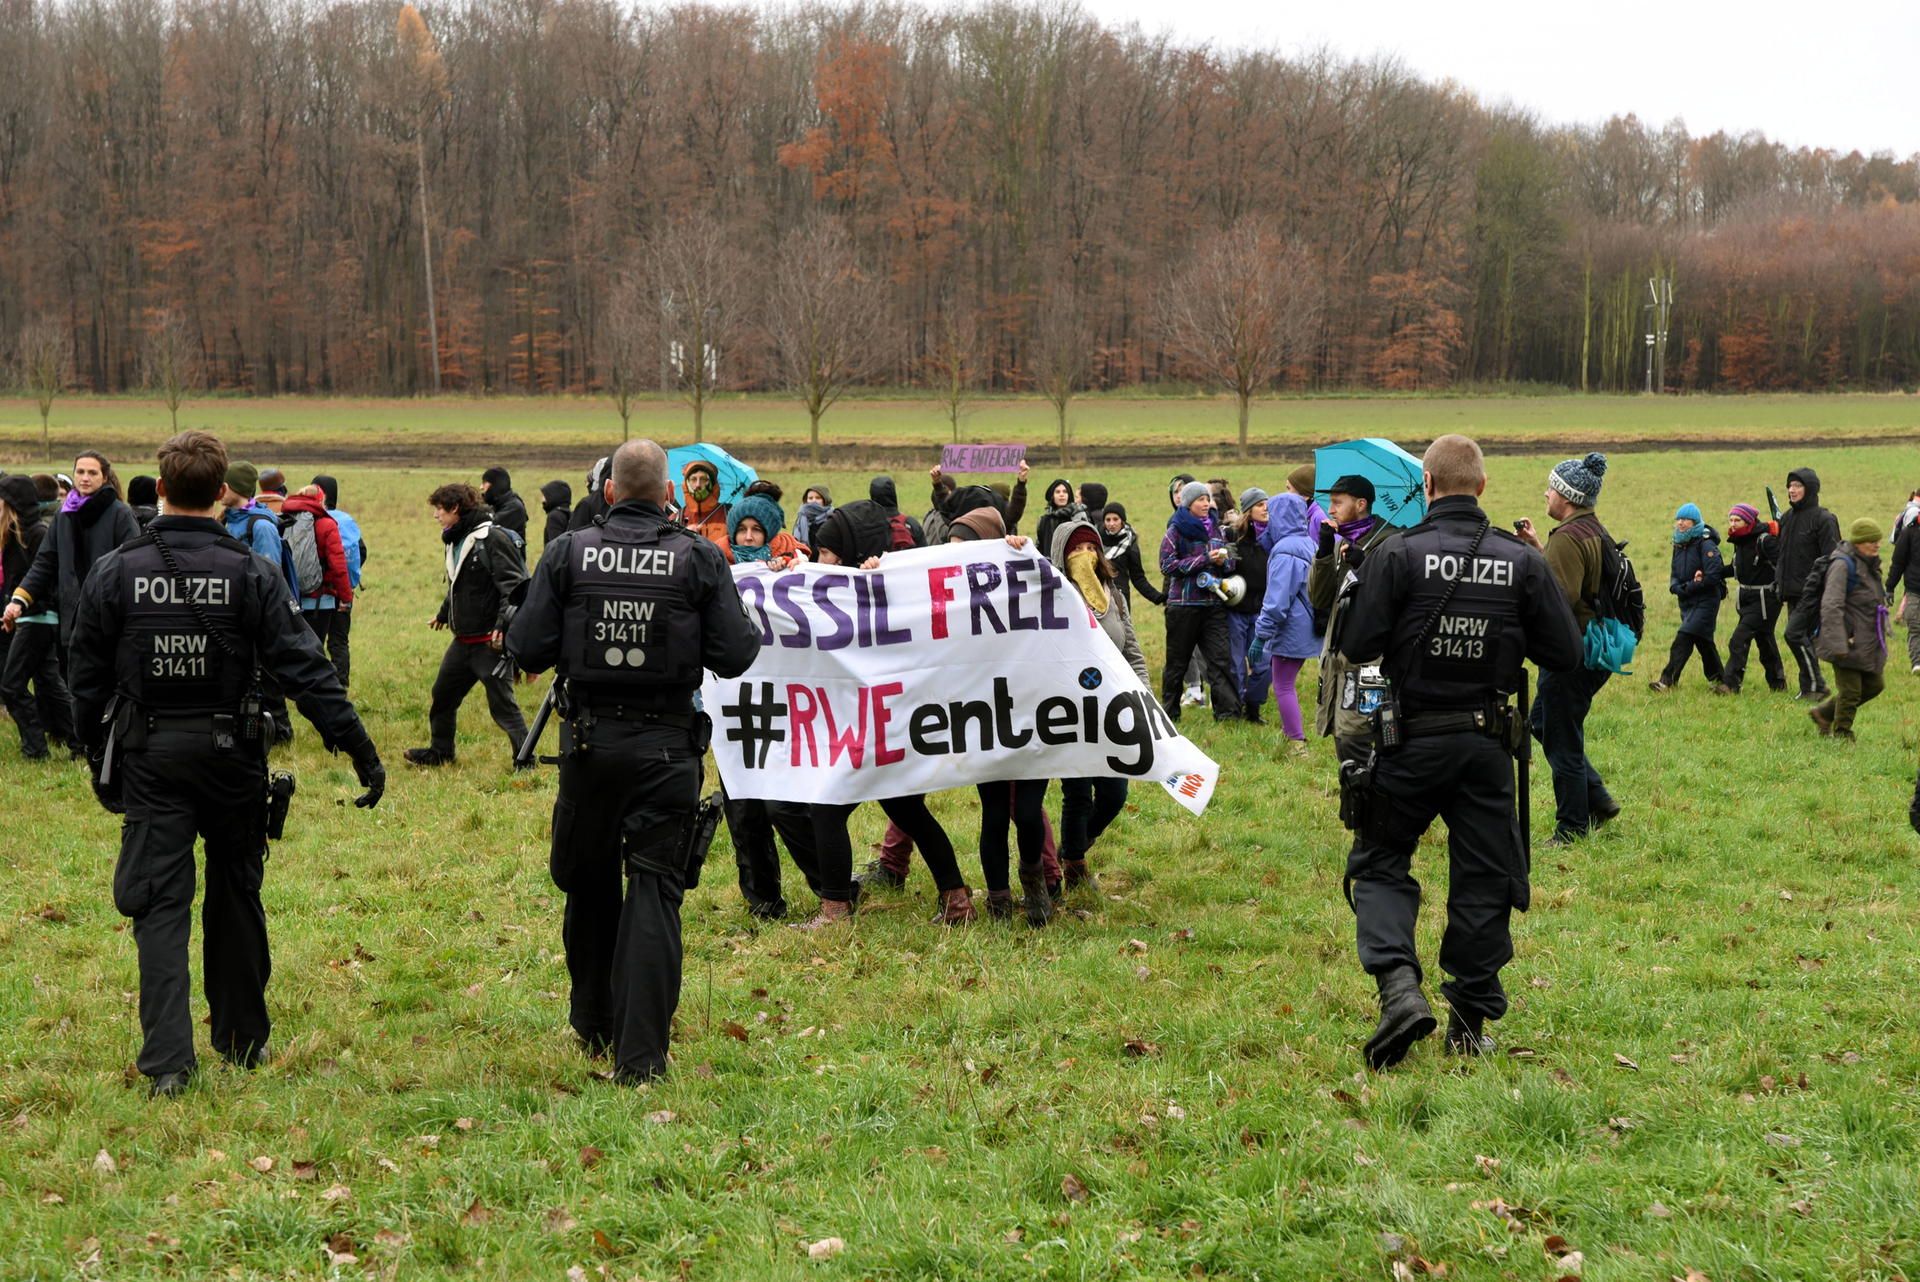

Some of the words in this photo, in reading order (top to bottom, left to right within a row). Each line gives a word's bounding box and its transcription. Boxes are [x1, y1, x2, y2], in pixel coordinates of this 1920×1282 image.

[941, 447, 968, 469] RWE
[582, 546, 675, 576] POLIZEI
[1424, 554, 1514, 586] POLIZEI
[603, 600, 655, 621] NRW
[737, 573, 912, 651] OSSIL
[928, 558, 1069, 640] FREE
[594, 622, 646, 643] 31411
[1438, 615, 1489, 637] NRW
[154, 635, 207, 654] NRW
[1430, 637, 1484, 659] 31413
[152, 657, 206, 677] 31411
